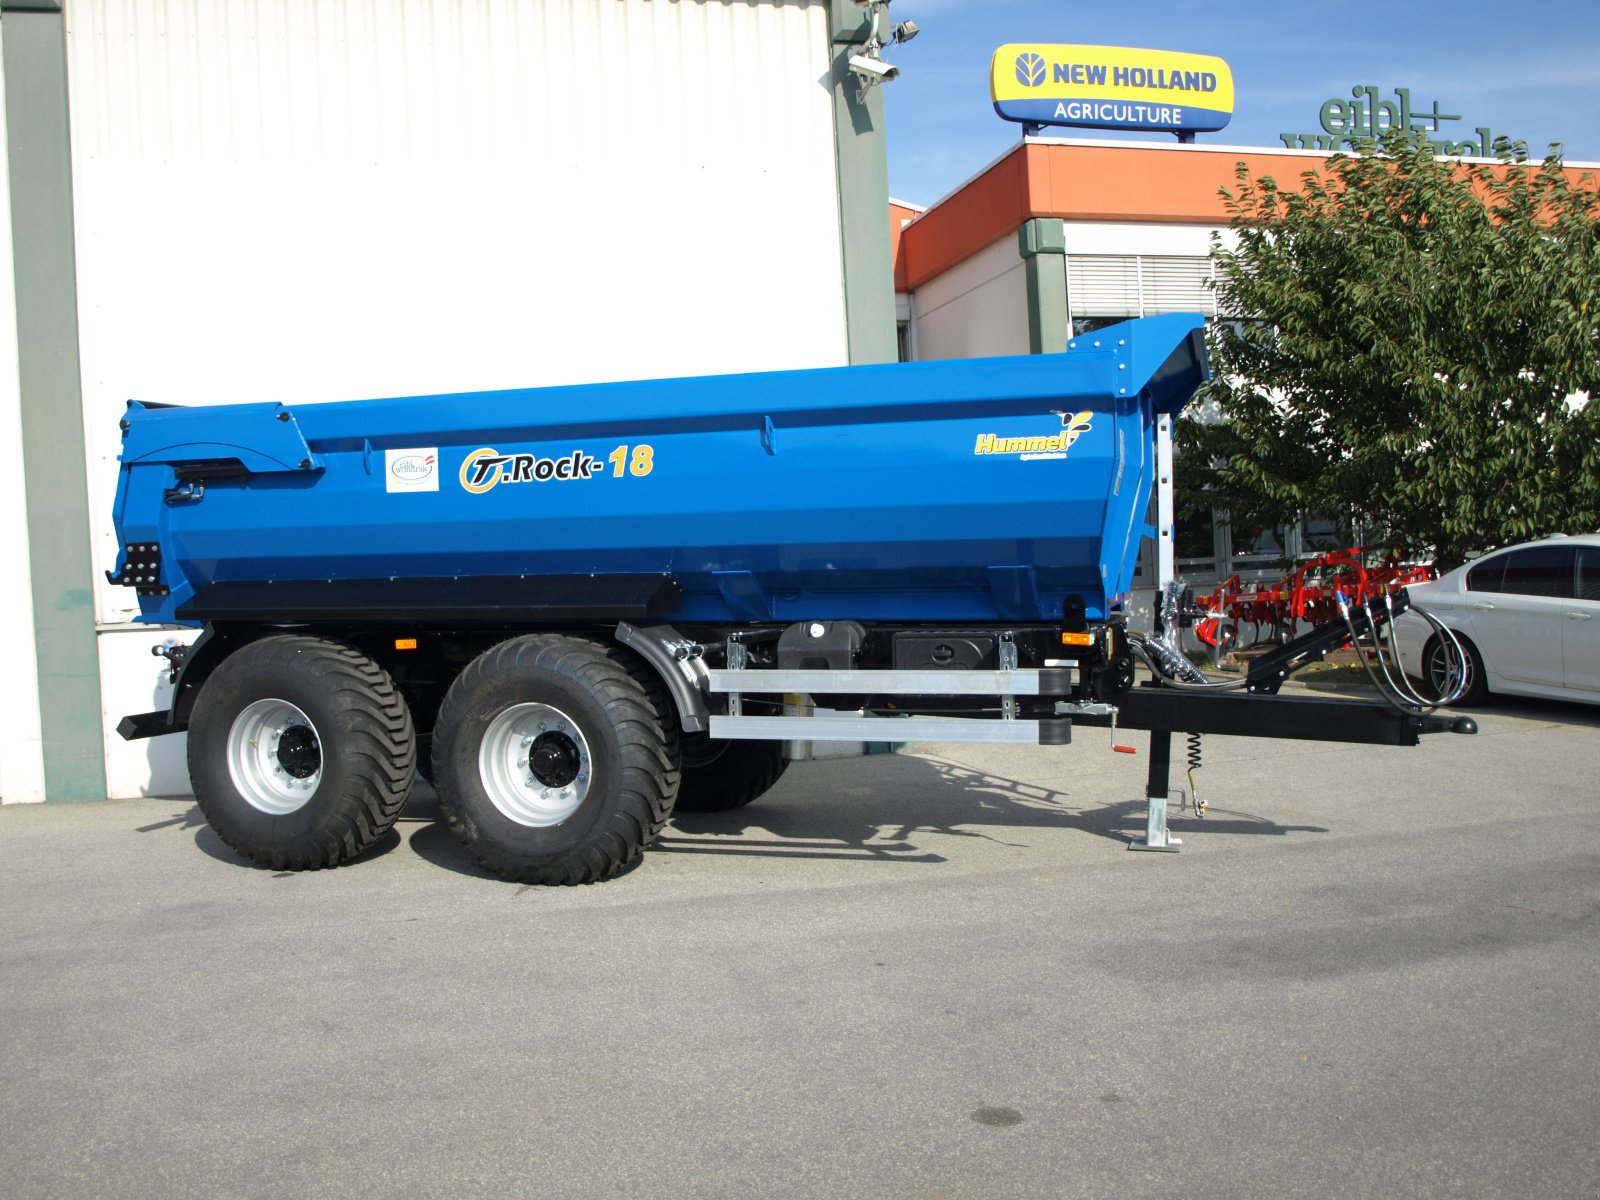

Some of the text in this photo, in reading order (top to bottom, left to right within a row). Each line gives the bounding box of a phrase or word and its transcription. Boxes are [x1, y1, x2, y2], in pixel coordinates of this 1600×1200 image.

[1053, 63, 1217, 92] NEW HOLLAND
[1054, 102, 1182, 124] AGRICULTURE
[976, 432, 1068, 454] Hummel
